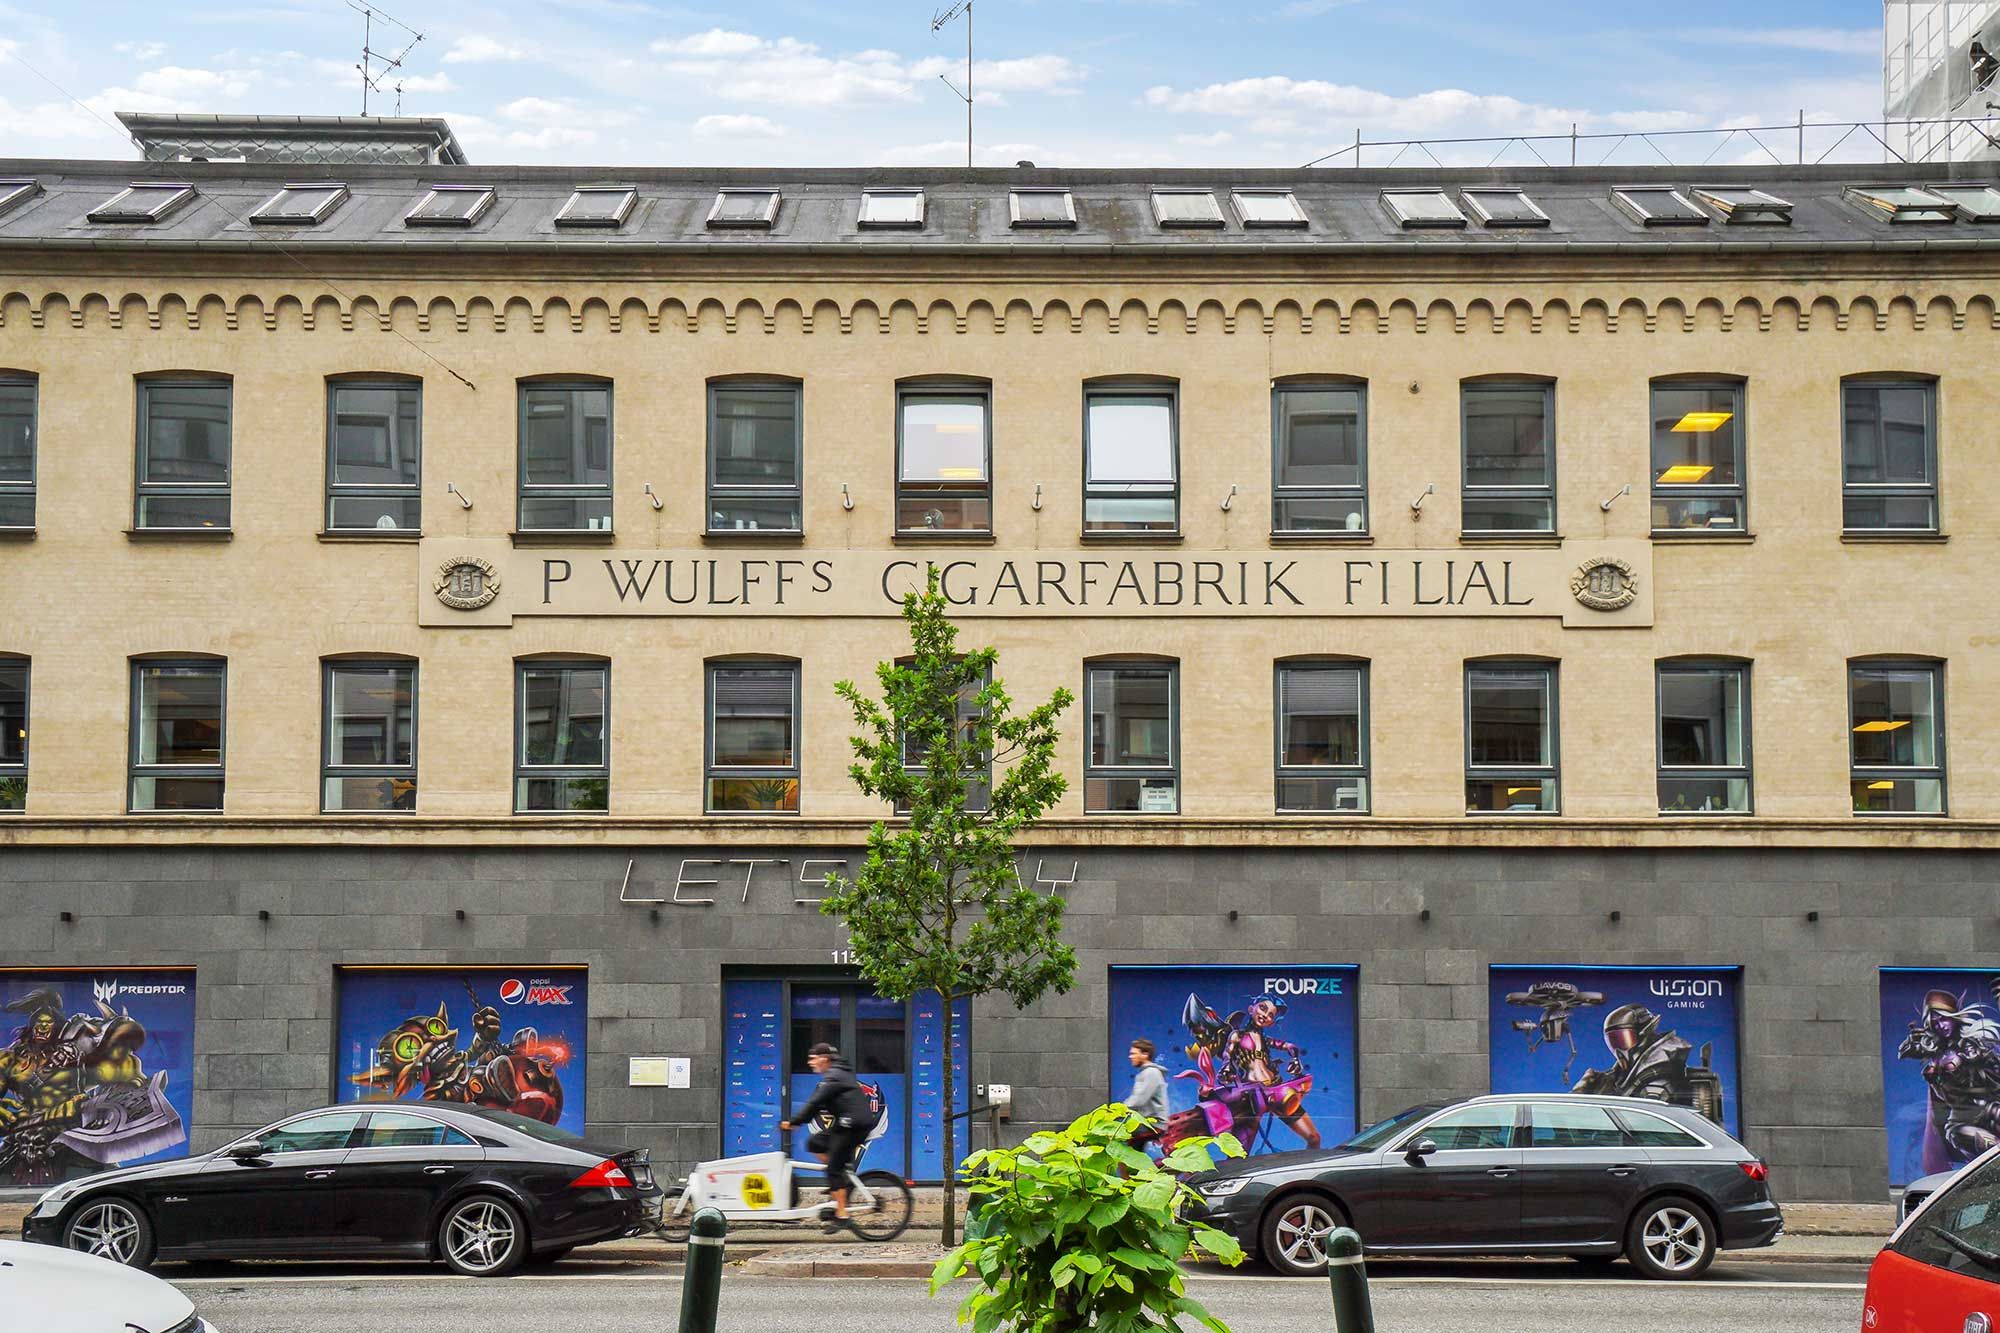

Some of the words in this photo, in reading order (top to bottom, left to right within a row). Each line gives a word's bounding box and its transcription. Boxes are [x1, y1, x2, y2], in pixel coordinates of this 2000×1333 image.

[541, 560, 571, 604] P
[602, 560, 833, 605] WULFFS
[881, 560, 1305, 606] CIGARFABRIK
[1344, 560, 1534, 606] FILIAL
[119, 985, 186, 995] PREDATOR
[525, 986, 574, 1005] MAX
[1264, 978, 1343, 995] FOURZE
